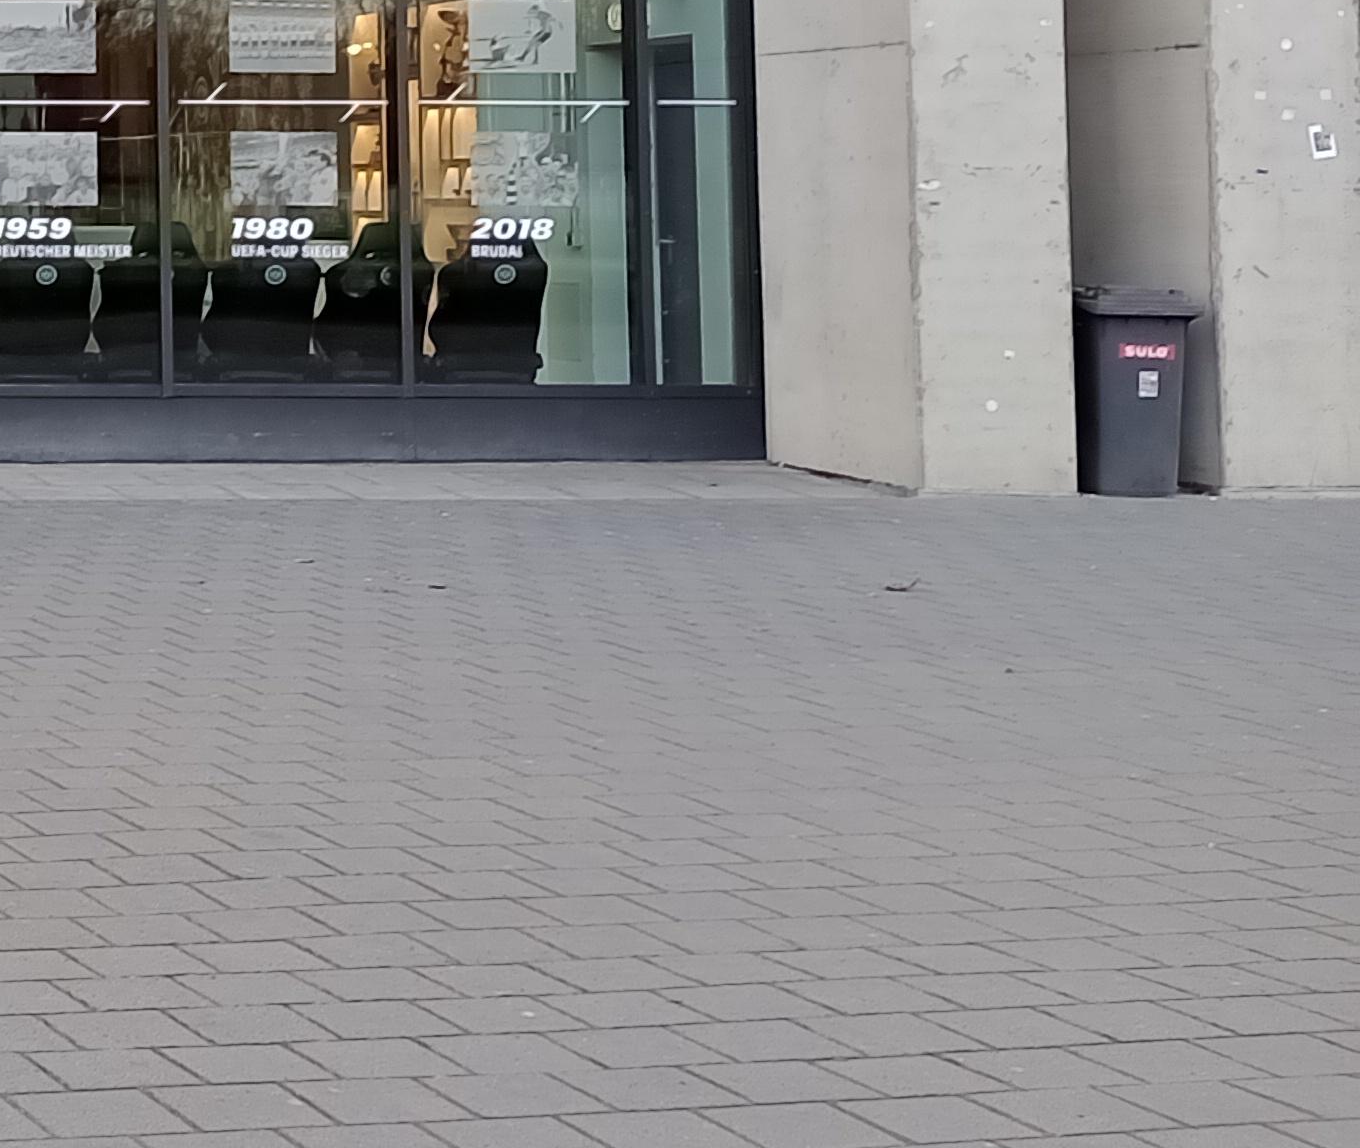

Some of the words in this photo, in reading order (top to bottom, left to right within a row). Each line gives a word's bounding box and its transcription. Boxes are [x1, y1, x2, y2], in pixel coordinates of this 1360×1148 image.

[232, 217, 314, 240] 1980
[470, 218, 555, 240] 2018
[74, 244, 132, 258] MEISTER
[231, 244, 298, 258] UEFA-CUP
[302, 244, 349, 258] SIEGER
[1124, 345, 1169, 358] SULO
